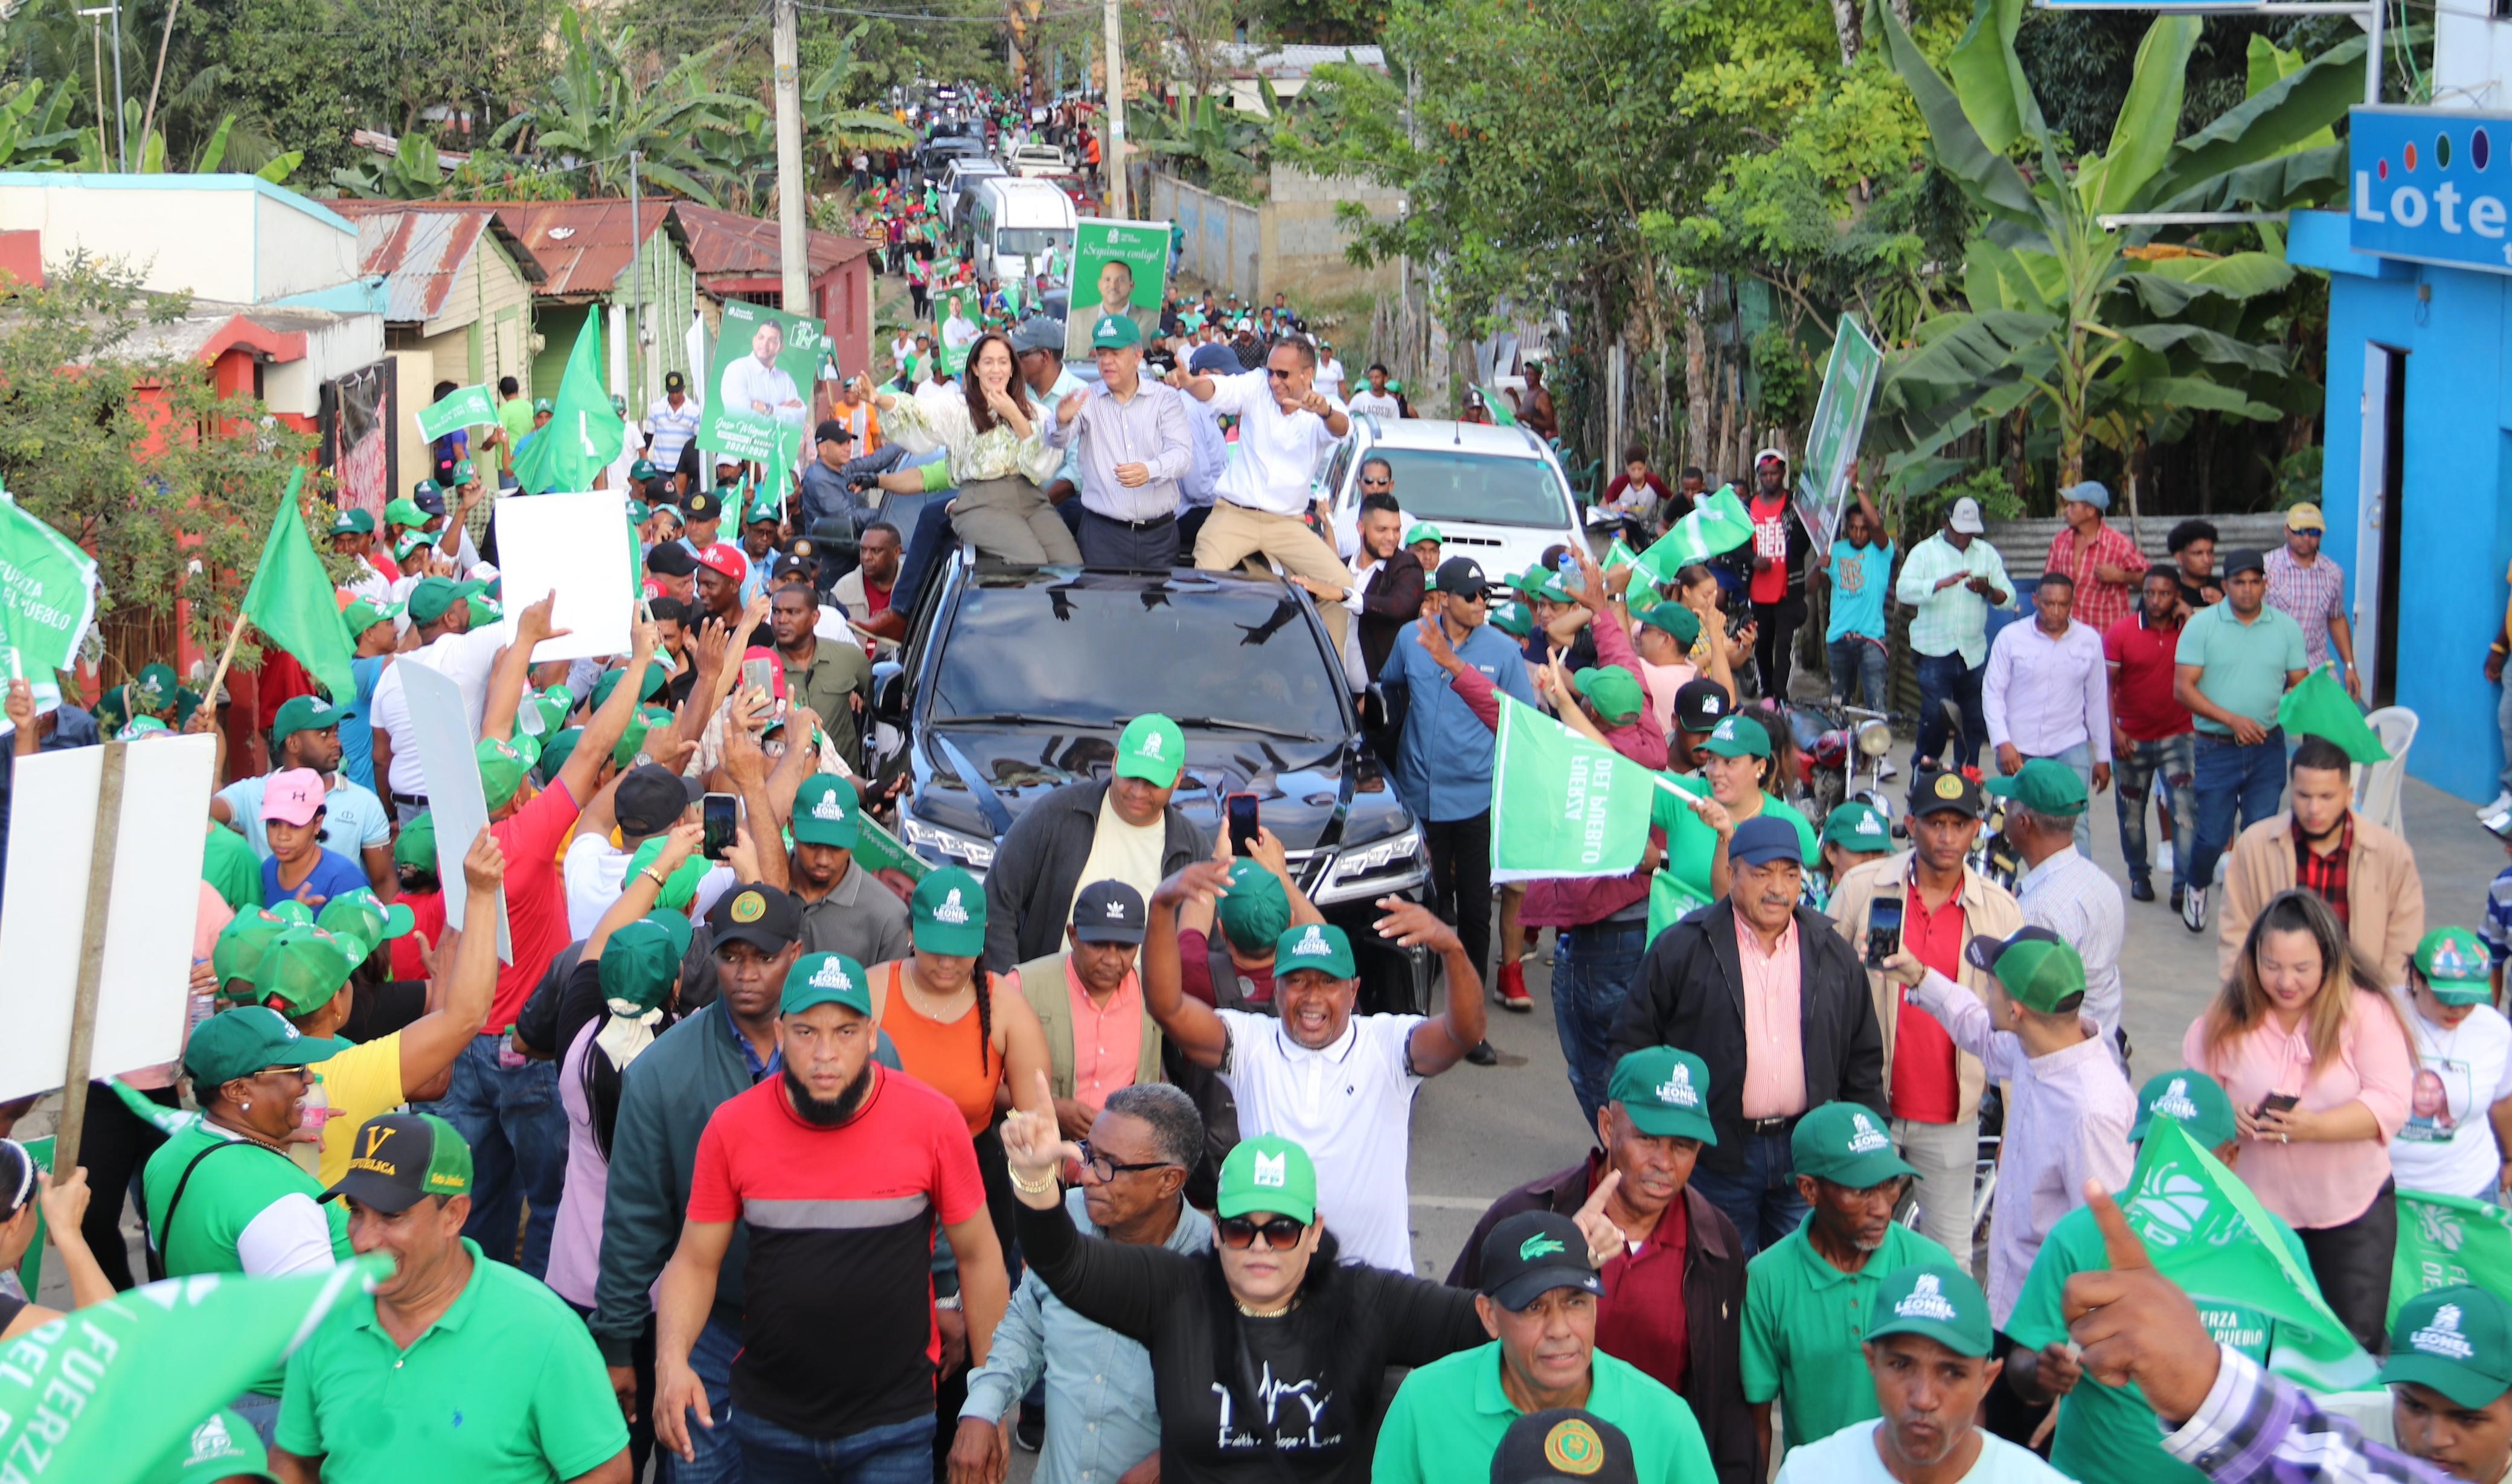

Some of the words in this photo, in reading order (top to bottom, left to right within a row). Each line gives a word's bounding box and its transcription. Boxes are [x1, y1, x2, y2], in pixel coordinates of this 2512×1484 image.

[1083, 241, 1125, 260] ¡Seguimos
[1127, 247, 1159, 264] contigo!
[1755, 523, 1784, 540] SEE
[1757, 540, 1786, 558] RED
[812, 806, 845, 819] LEONEL
[933, 906, 970, 922] LEONEL
[1292, 943, 1332, 955] LEONEL
[809, 974, 853, 990] LEONEL
[1656, 1084, 1699, 1104] LEONEL
[365, 1125, 397, 1158] V
[1847, 1134, 1889, 1152] LEONEL
[1894, 1299, 1956, 1319] LEONEL
[2409, 1331, 2475, 1357] LEONEL
